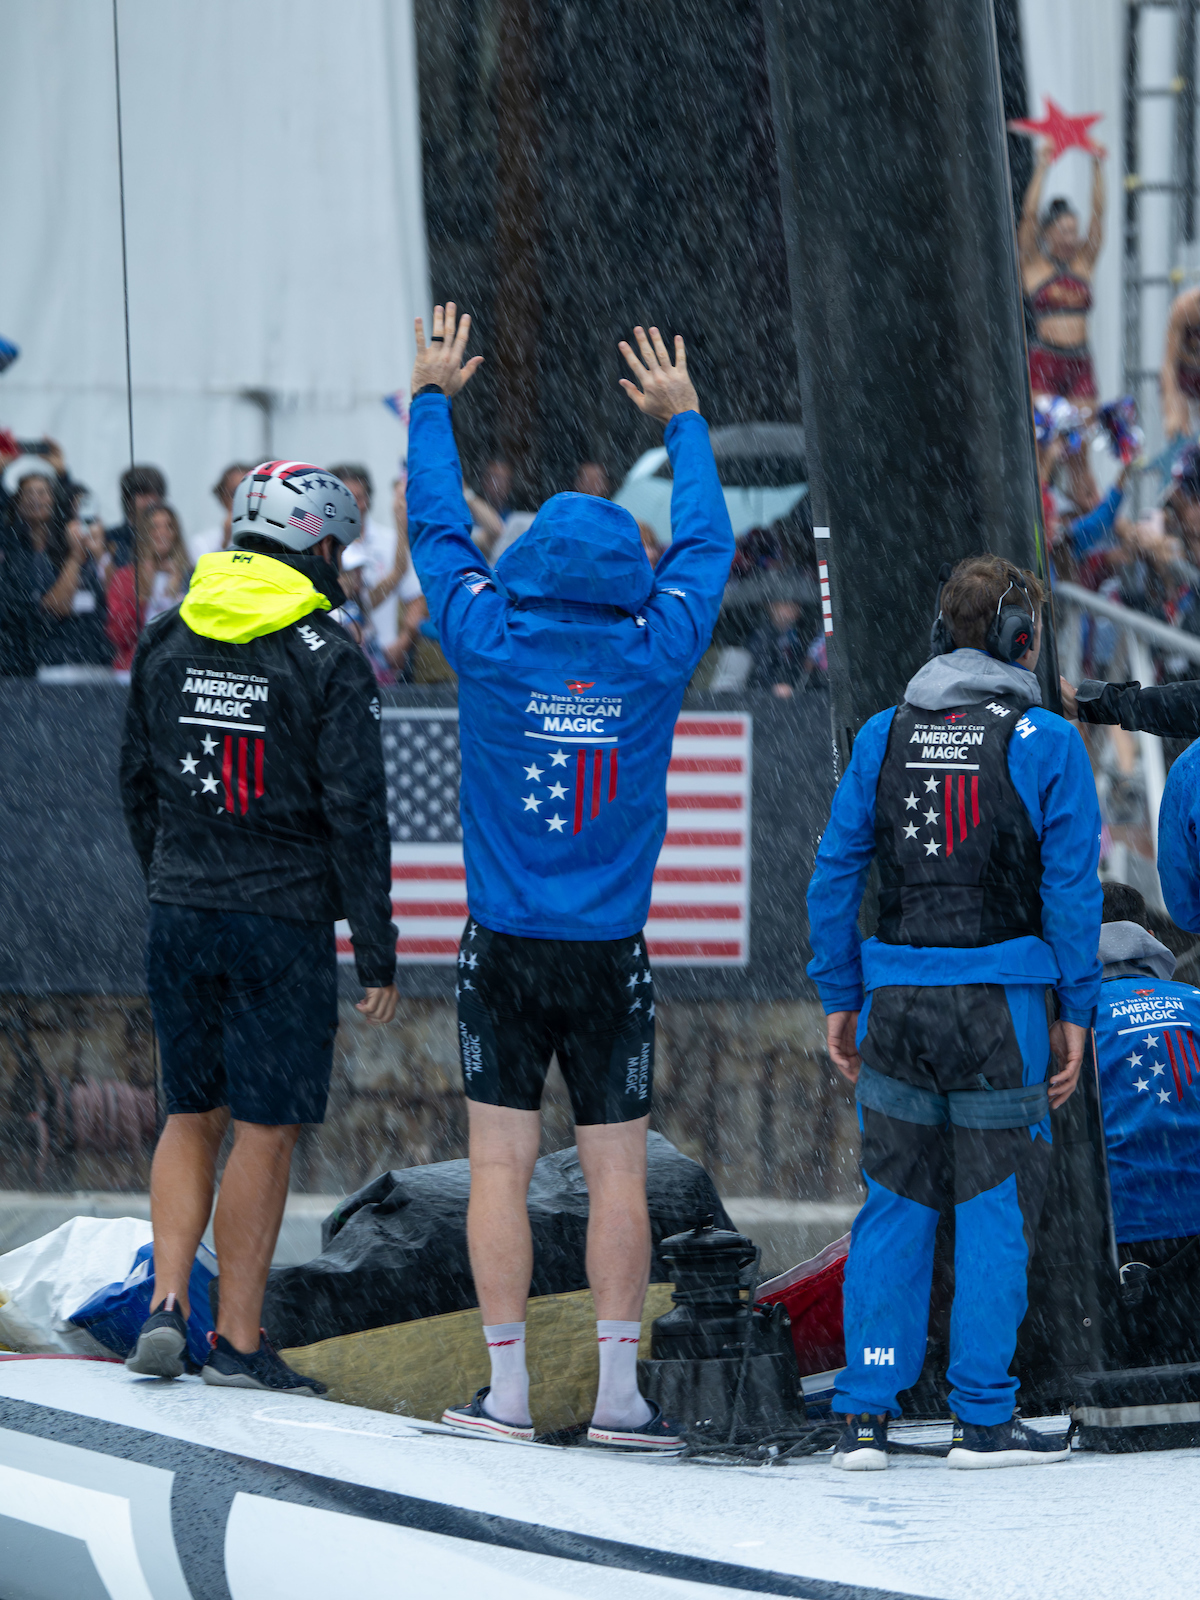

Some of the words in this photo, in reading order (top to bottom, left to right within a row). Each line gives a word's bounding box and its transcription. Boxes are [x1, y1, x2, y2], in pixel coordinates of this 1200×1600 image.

[232, 553, 254, 564] HH
[296, 624, 327, 652] HH
[181, 677, 269, 702] AMERICAN
[530, 691, 549, 700] NEW
[551, 694, 572, 702] YORK
[574, 695, 601, 703] YACHT
[194, 696, 253, 719] MAGIC
[524, 700, 622, 717] AMERICAN
[985, 701, 1011, 718] HH
[543, 716, 605, 733] MAGIC
[909, 730, 984, 745] AMERICAN
[921, 745, 969, 760] MAGIC
[1112, 1000, 1184, 1018] AMERICAN
[1129, 1009, 1177, 1025] MAGIC
[459, 1020, 473, 1081] AMERICAN
[468, 1033, 483, 1073] MAGIC
[625, 1056, 640, 1095] MAGIC
[638, 1042, 650, 1100] AMERICAN
[863, 1347, 895, 1366] HH
[857, 1428, 874, 1437] HH
[1011, 1429, 1028, 1441] HH
